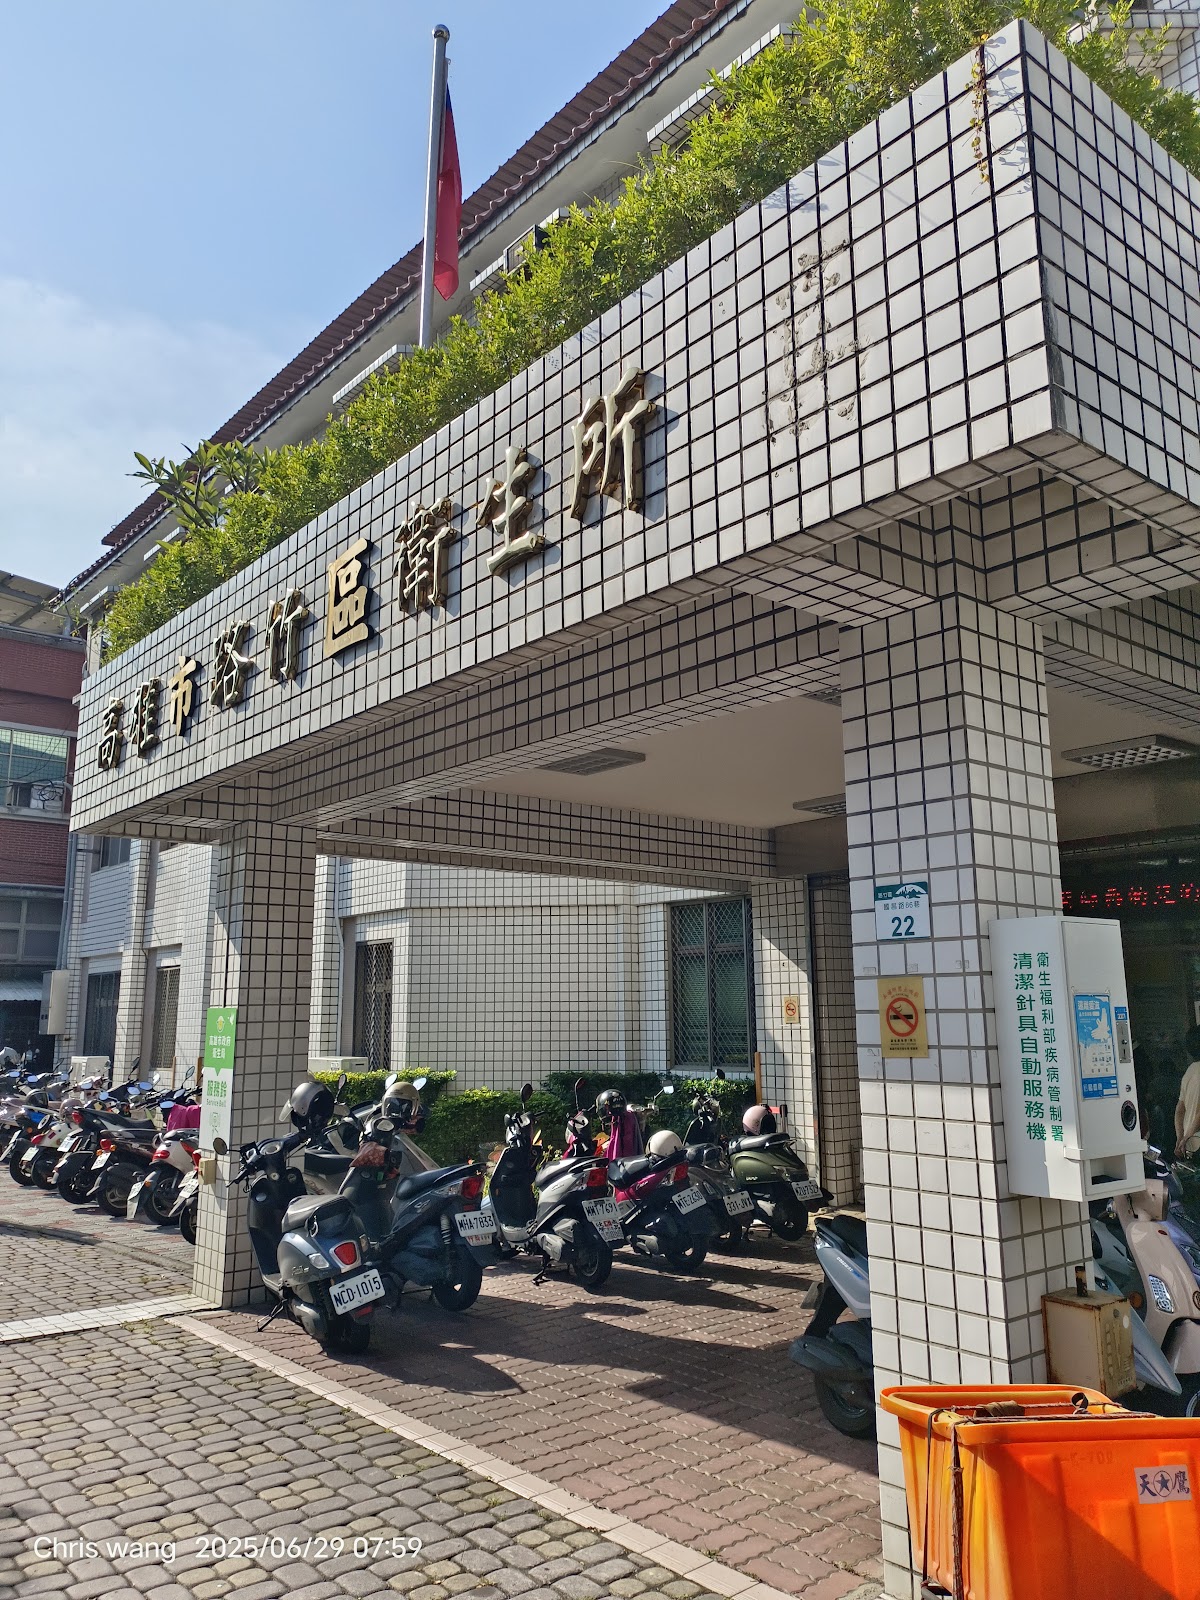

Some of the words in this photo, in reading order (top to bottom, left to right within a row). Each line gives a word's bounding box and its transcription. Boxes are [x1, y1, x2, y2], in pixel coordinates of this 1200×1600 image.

[97, 366, 657, 770] 高雄市路竹區衛生所
[891, 915, 915, 937] 22
[1013, 952, 1047, 1142] 清潔針具自動服務機
[1036, 952, 1064, 1142] 衛生福利部疾病管制署
[457, 1215, 494, 1231] MHA-7833
[333, 1277, 381, 1308] NCD-1015
